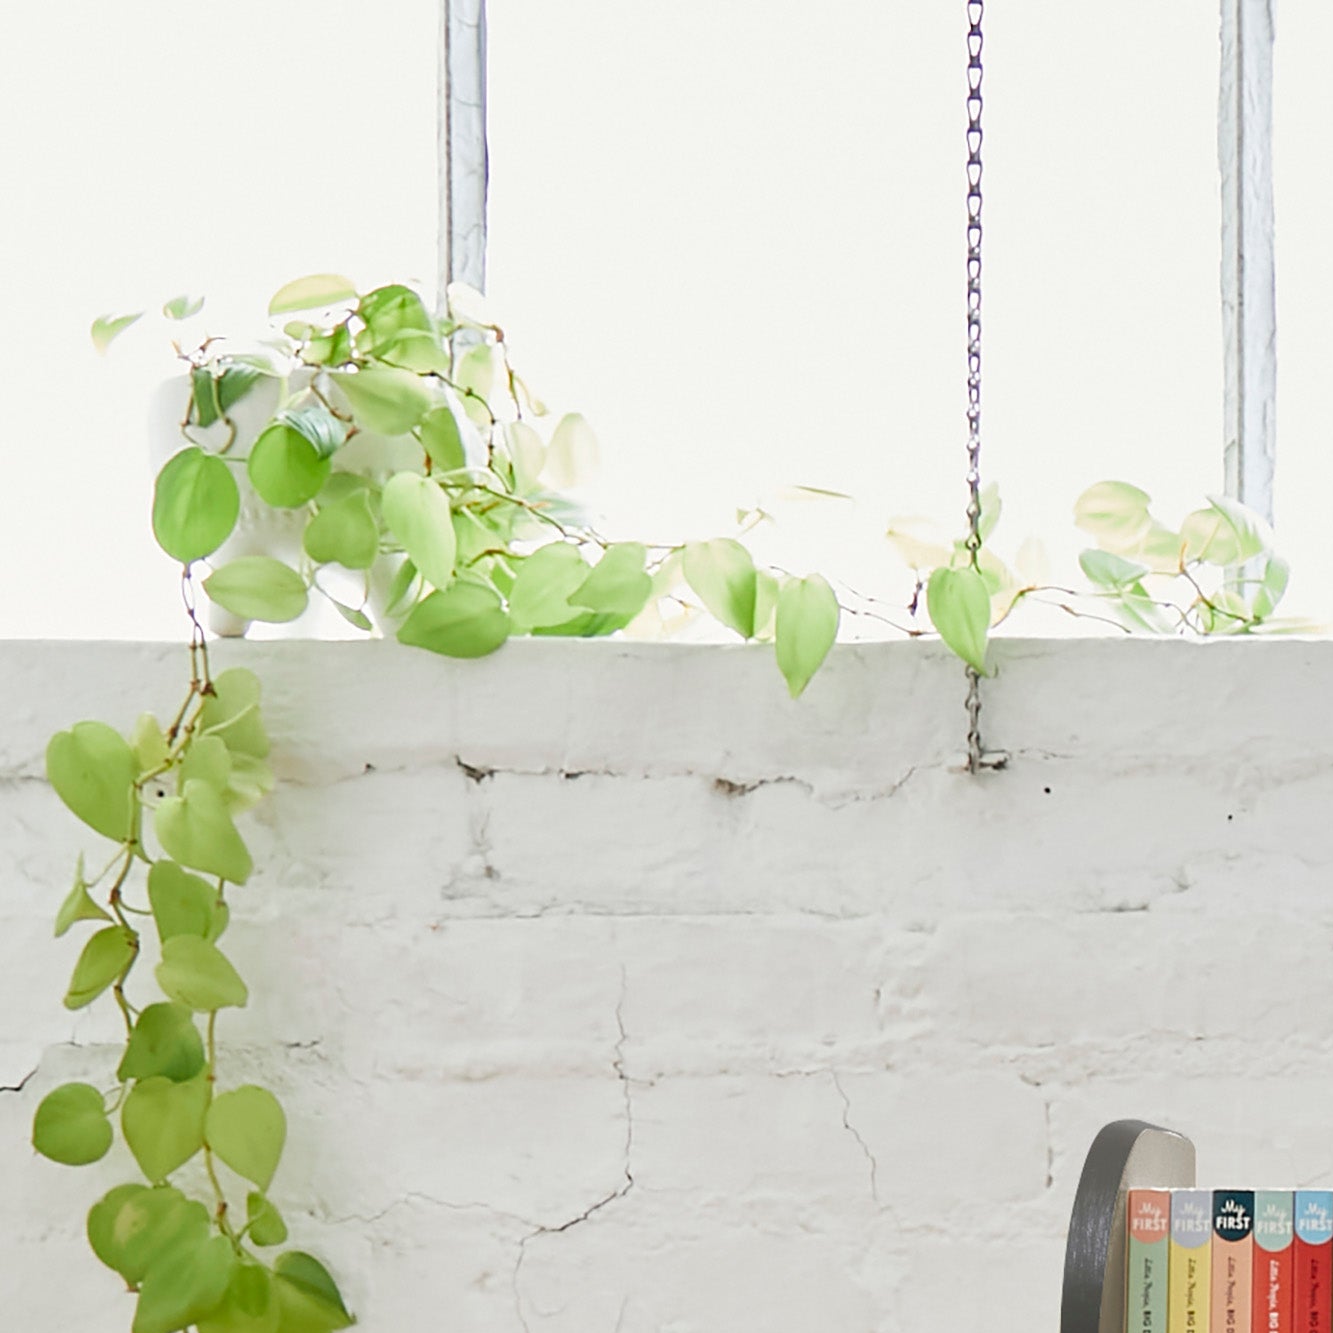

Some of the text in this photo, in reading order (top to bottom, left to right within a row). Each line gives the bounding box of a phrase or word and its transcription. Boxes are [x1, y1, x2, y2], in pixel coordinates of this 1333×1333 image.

[1221, 1200, 1245, 1220] My
[1304, 1202, 1327, 1221] My
[1216, 1216, 1250, 1229] FIRST
[1300, 1218, 1332, 1231] FIRST
[1269, 1312, 1278, 1328] BIG
